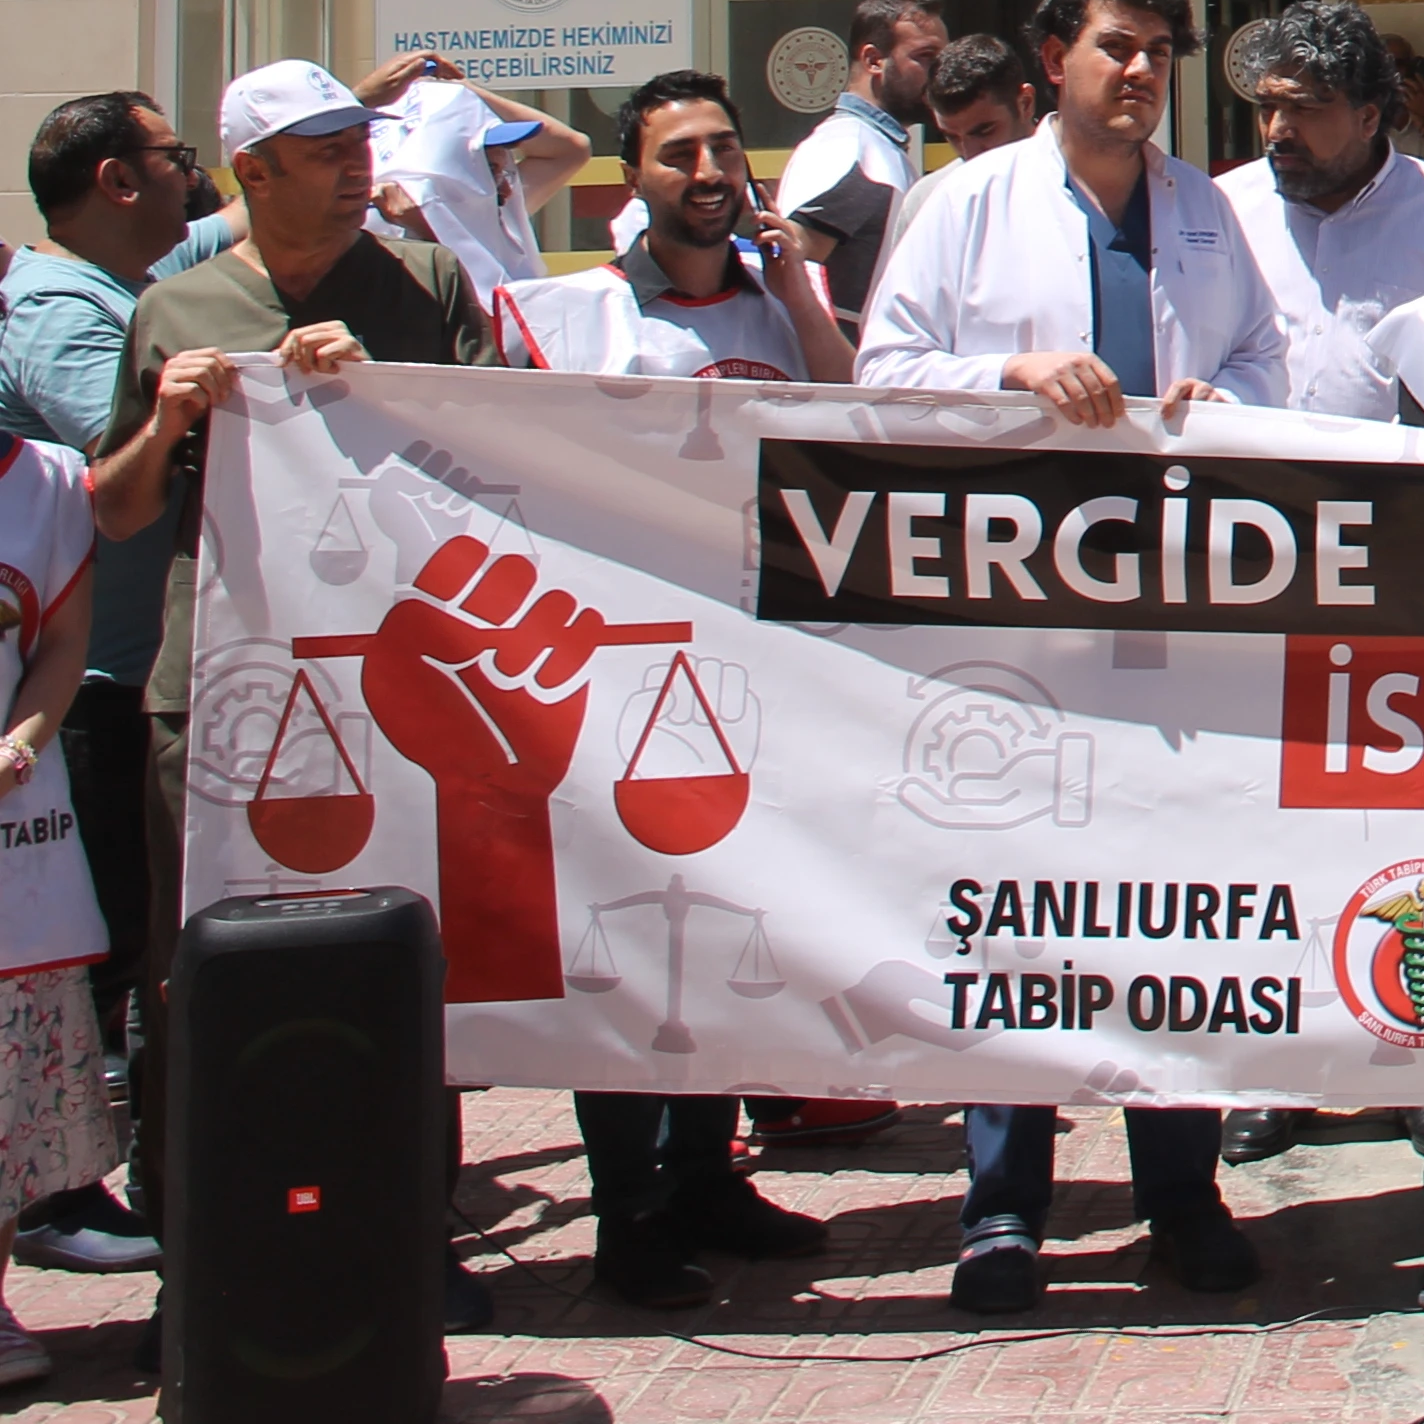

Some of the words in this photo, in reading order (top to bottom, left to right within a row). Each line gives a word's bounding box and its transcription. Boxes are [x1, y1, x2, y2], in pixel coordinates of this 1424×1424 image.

[394, 24, 556, 52] HASTANEMİZDE
[562, 19, 674, 48] HEKİMİNİZİ
[782, 464, 1376, 607] VERGİDE
[0, 808, 74, 849] TABİP
[1359, 874, 1388, 898] TÜRK
[945, 879, 1301, 956] ŞANLIURFA
[944, 960, 1115, 1031] TABİP
[1127, 975, 1301, 1035] ODASI
